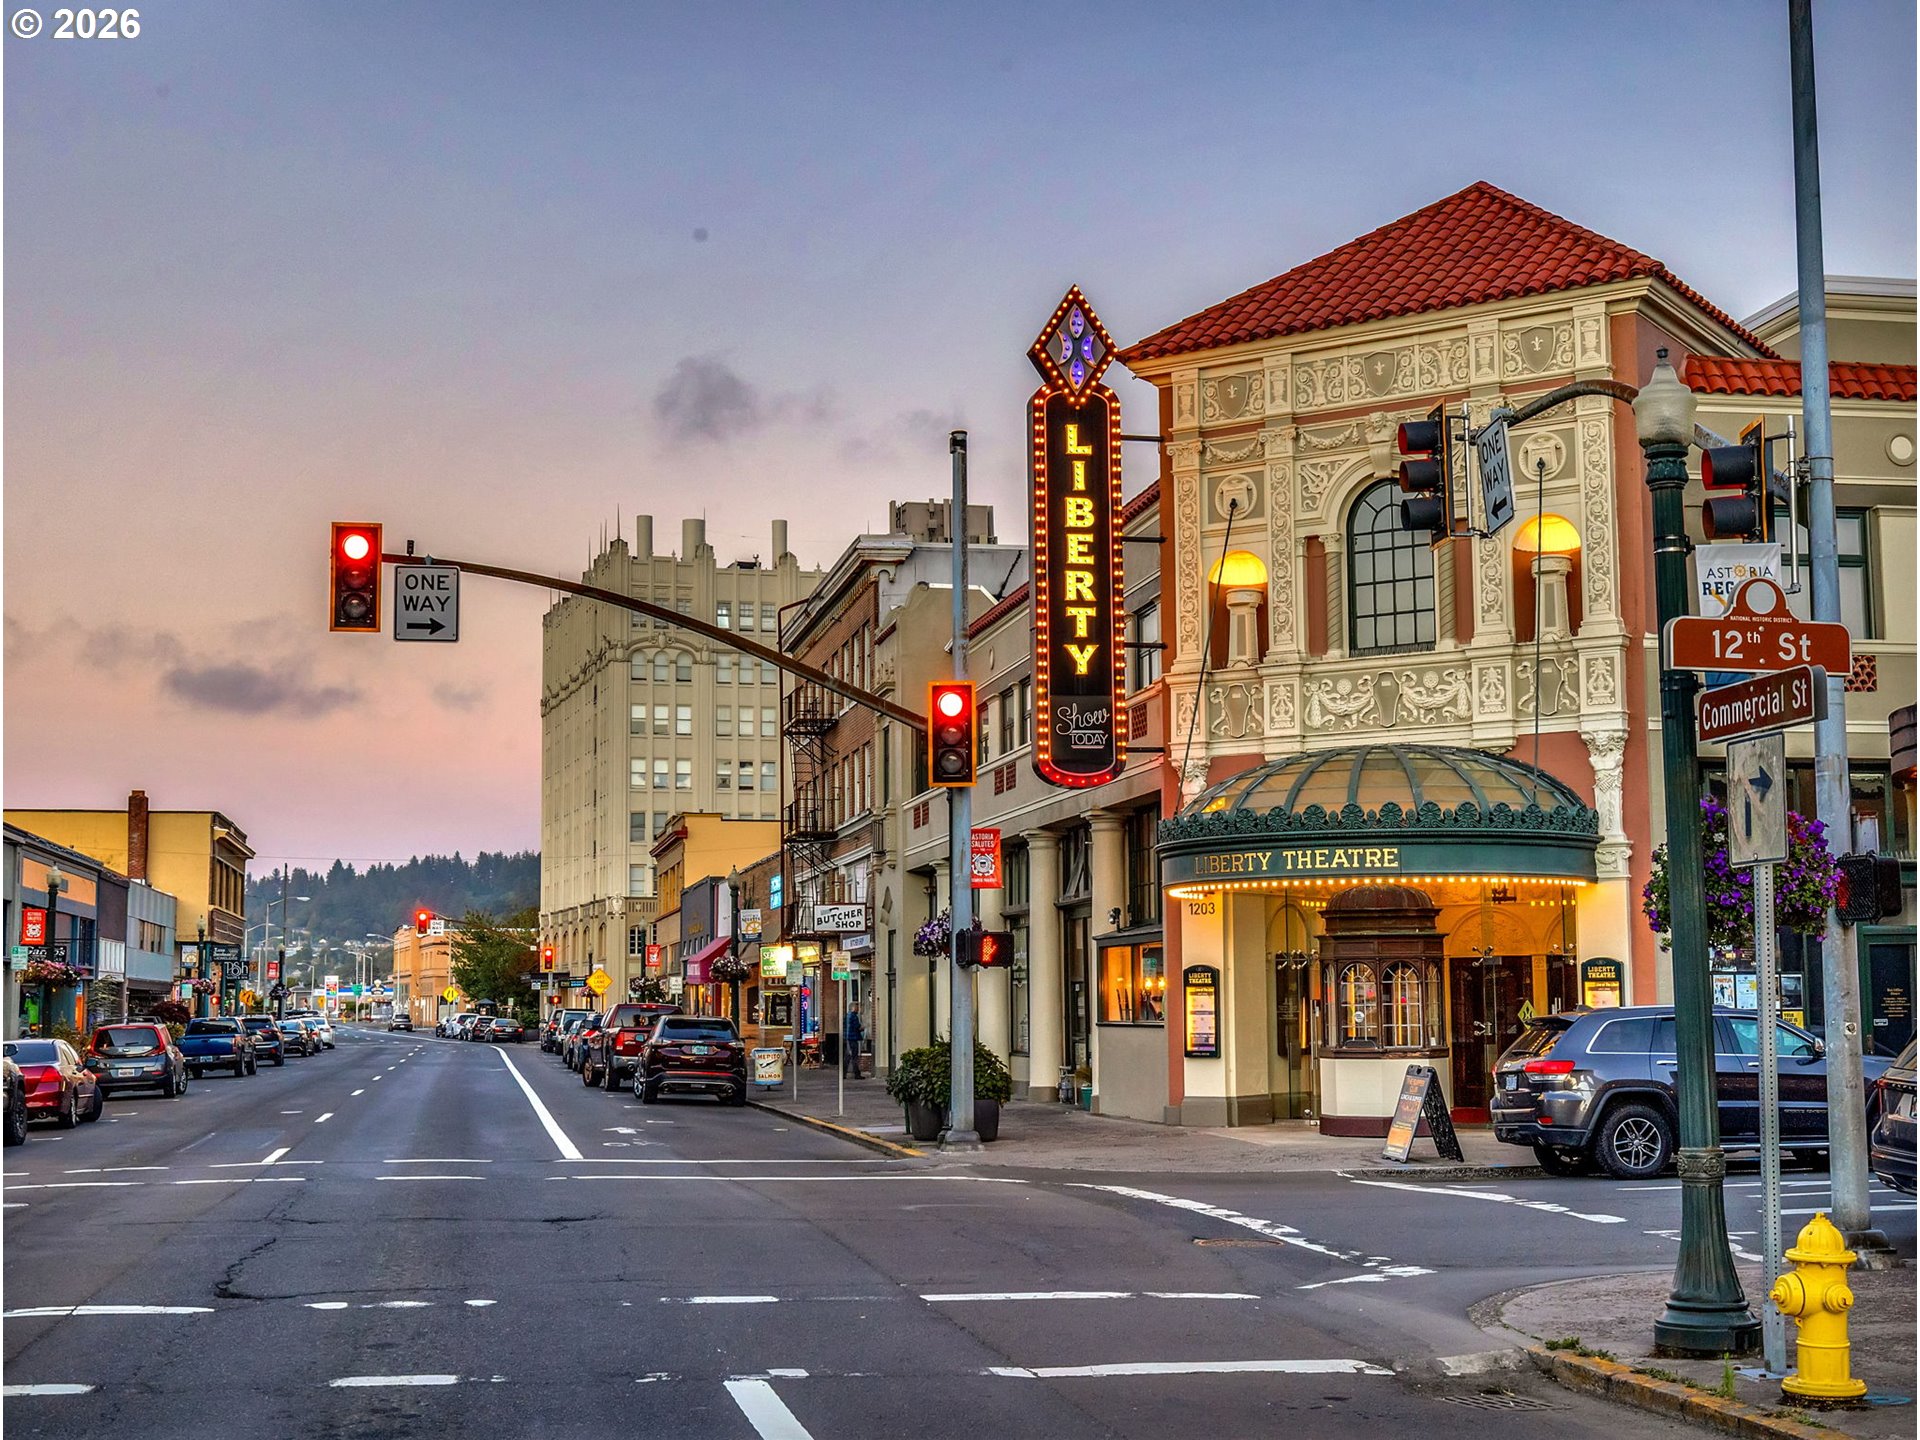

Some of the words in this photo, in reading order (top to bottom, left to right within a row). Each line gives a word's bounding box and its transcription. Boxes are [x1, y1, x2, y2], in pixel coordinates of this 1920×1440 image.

[1482, 430, 1502, 464] ONE
[1484, 458, 1506, 493] WAY
[1063, 423, 1099, 676] LIBERTY
[404, 574, 450, 591] ONE
[403, 596, 451, 612] WAY
[1712, 629, 1761, 659] 12th
[1778, 632, 1811, 662] St
[1702, 684, 1785, 731] Commercial
[1792, 679, 1807, 709] St
[1055, 702, 1111, 735] Show
[1069, 733, 1109, 745] TODAY
[971, 833, 994, 841] ASTORIA
[1194, 851, 1272, 875] LIBERTY
[1282, 847, 1400, 870] THEATRE
[816, 908, 863, 926] BUTCHER
[1188, 902, 1216, 916] 1203
[835, 920, 862, 929] SHOP
